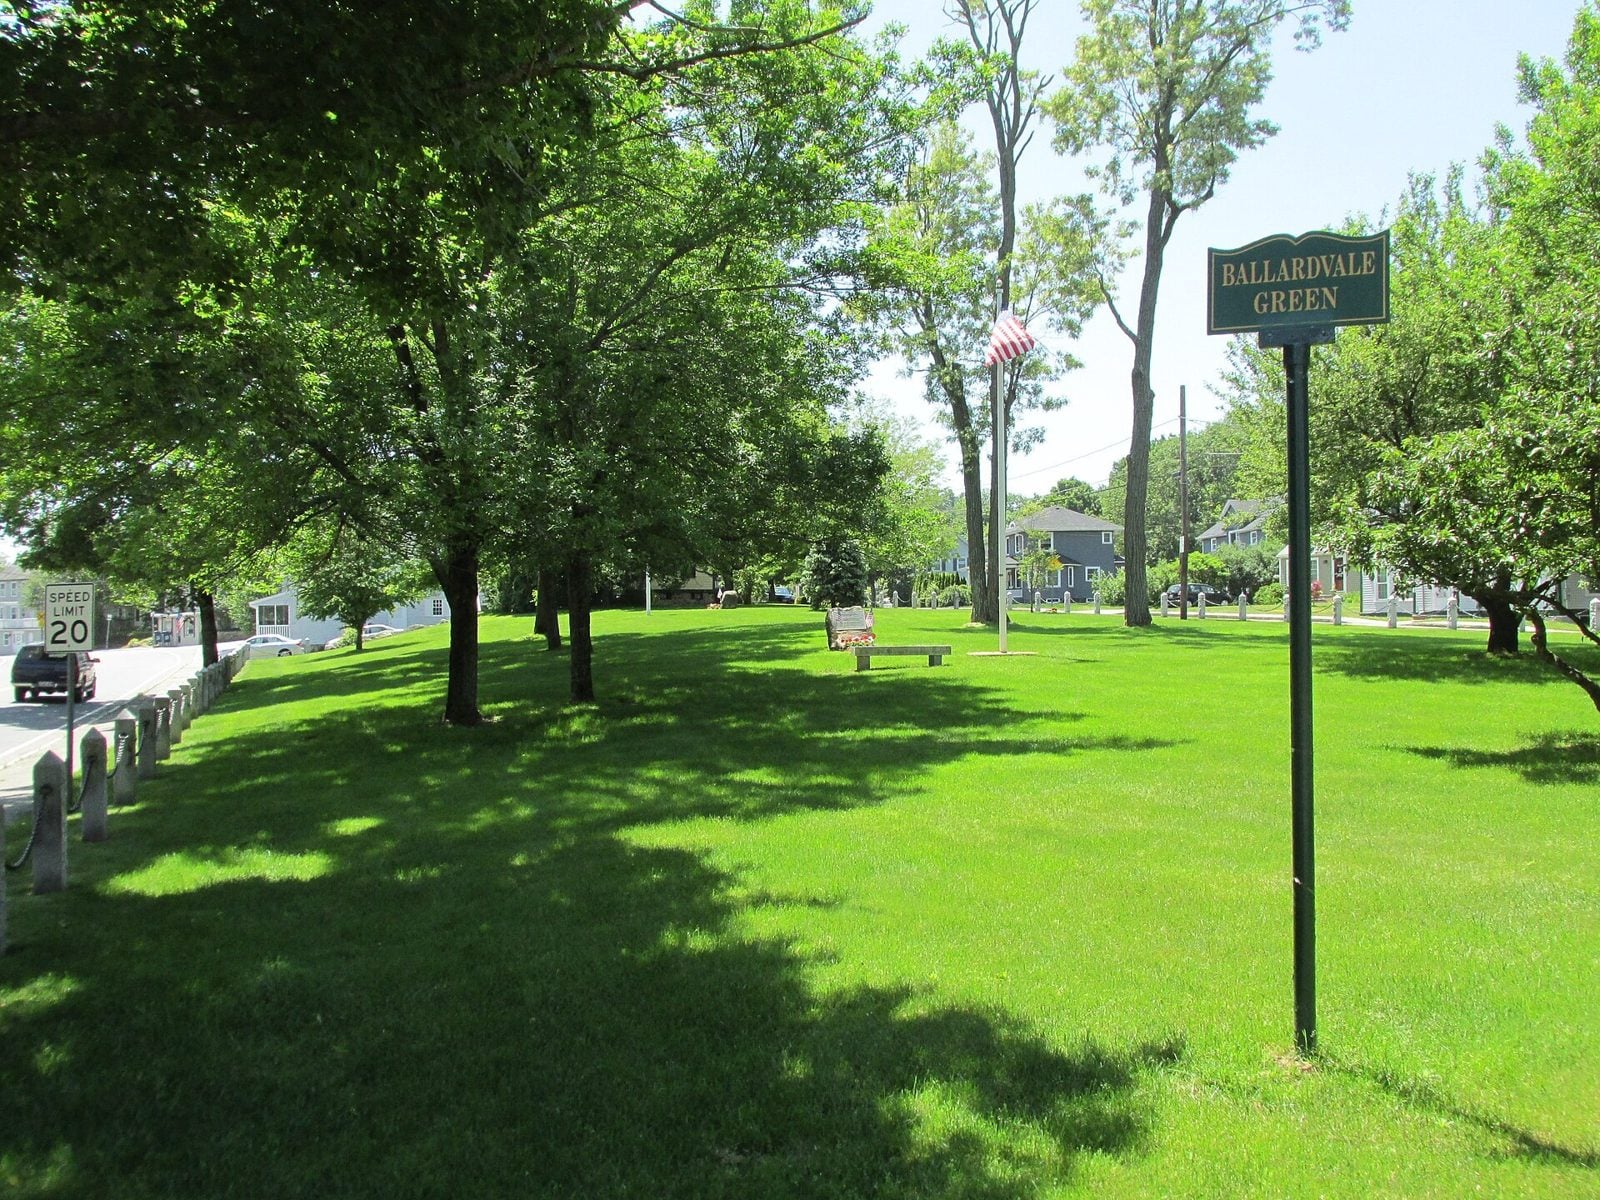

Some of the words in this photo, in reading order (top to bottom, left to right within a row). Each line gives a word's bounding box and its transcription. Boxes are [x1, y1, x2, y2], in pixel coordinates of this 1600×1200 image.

[1222, 251, 1375, 286] BALLARDVALE
[1253, 287, 1338, 314] GREEN
[50, 591, 90, 602] SPEED
[53, 605, 84, 617] LIMIT
[51, 620, 88, 644] 20
